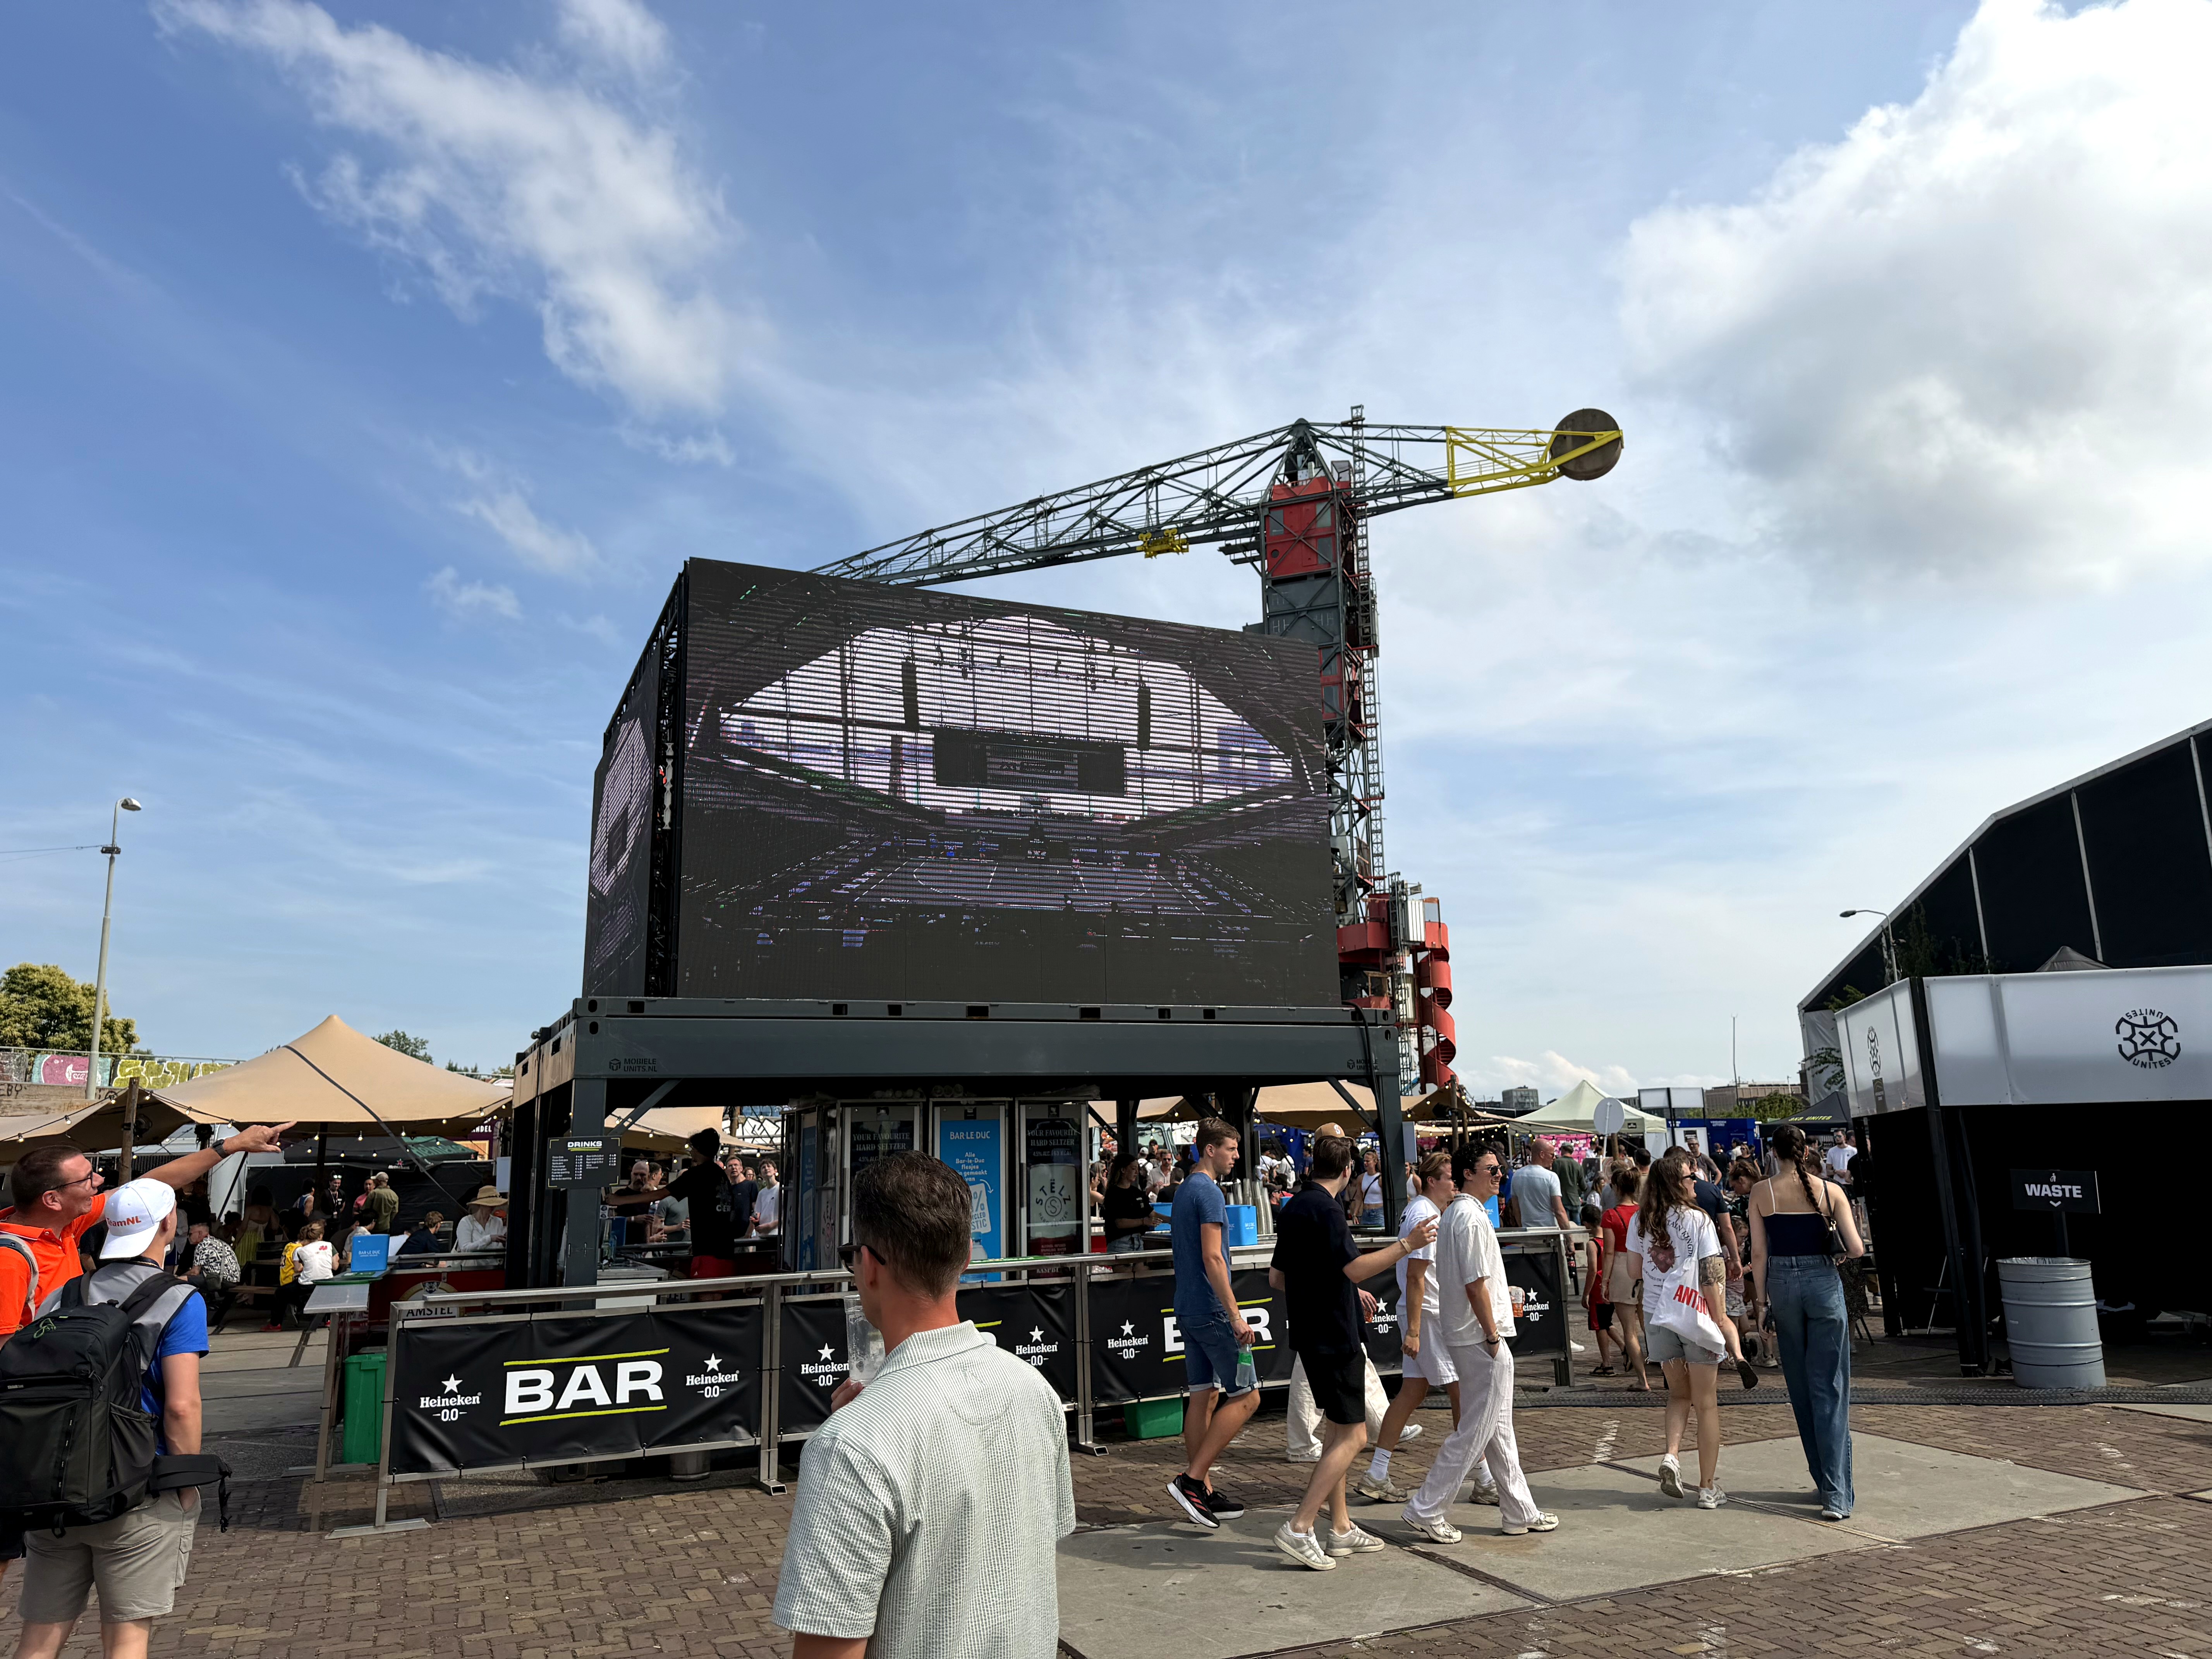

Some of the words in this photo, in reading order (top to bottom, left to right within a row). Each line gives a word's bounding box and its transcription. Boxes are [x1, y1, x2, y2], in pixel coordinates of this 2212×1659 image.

[2132, 1058, 2171, 1069] UNITES
[1045, 1128, 1078, 1137] FAVOURITE
[2024, 1183, 2083, 1198] WASTE
[1522, 1302, 1549, 1312] eineken
[1108, 1337, 1149, 1348] Heineken
[1015, 1343, 1058, 1355] Heineken
[801, 1362, 850, 1374] Heineken
[685, 1372, 738, 1386] Heineken
[505, 1360, 664, 1414] BAR
[419, 1394, 481, 1408] Heineken
